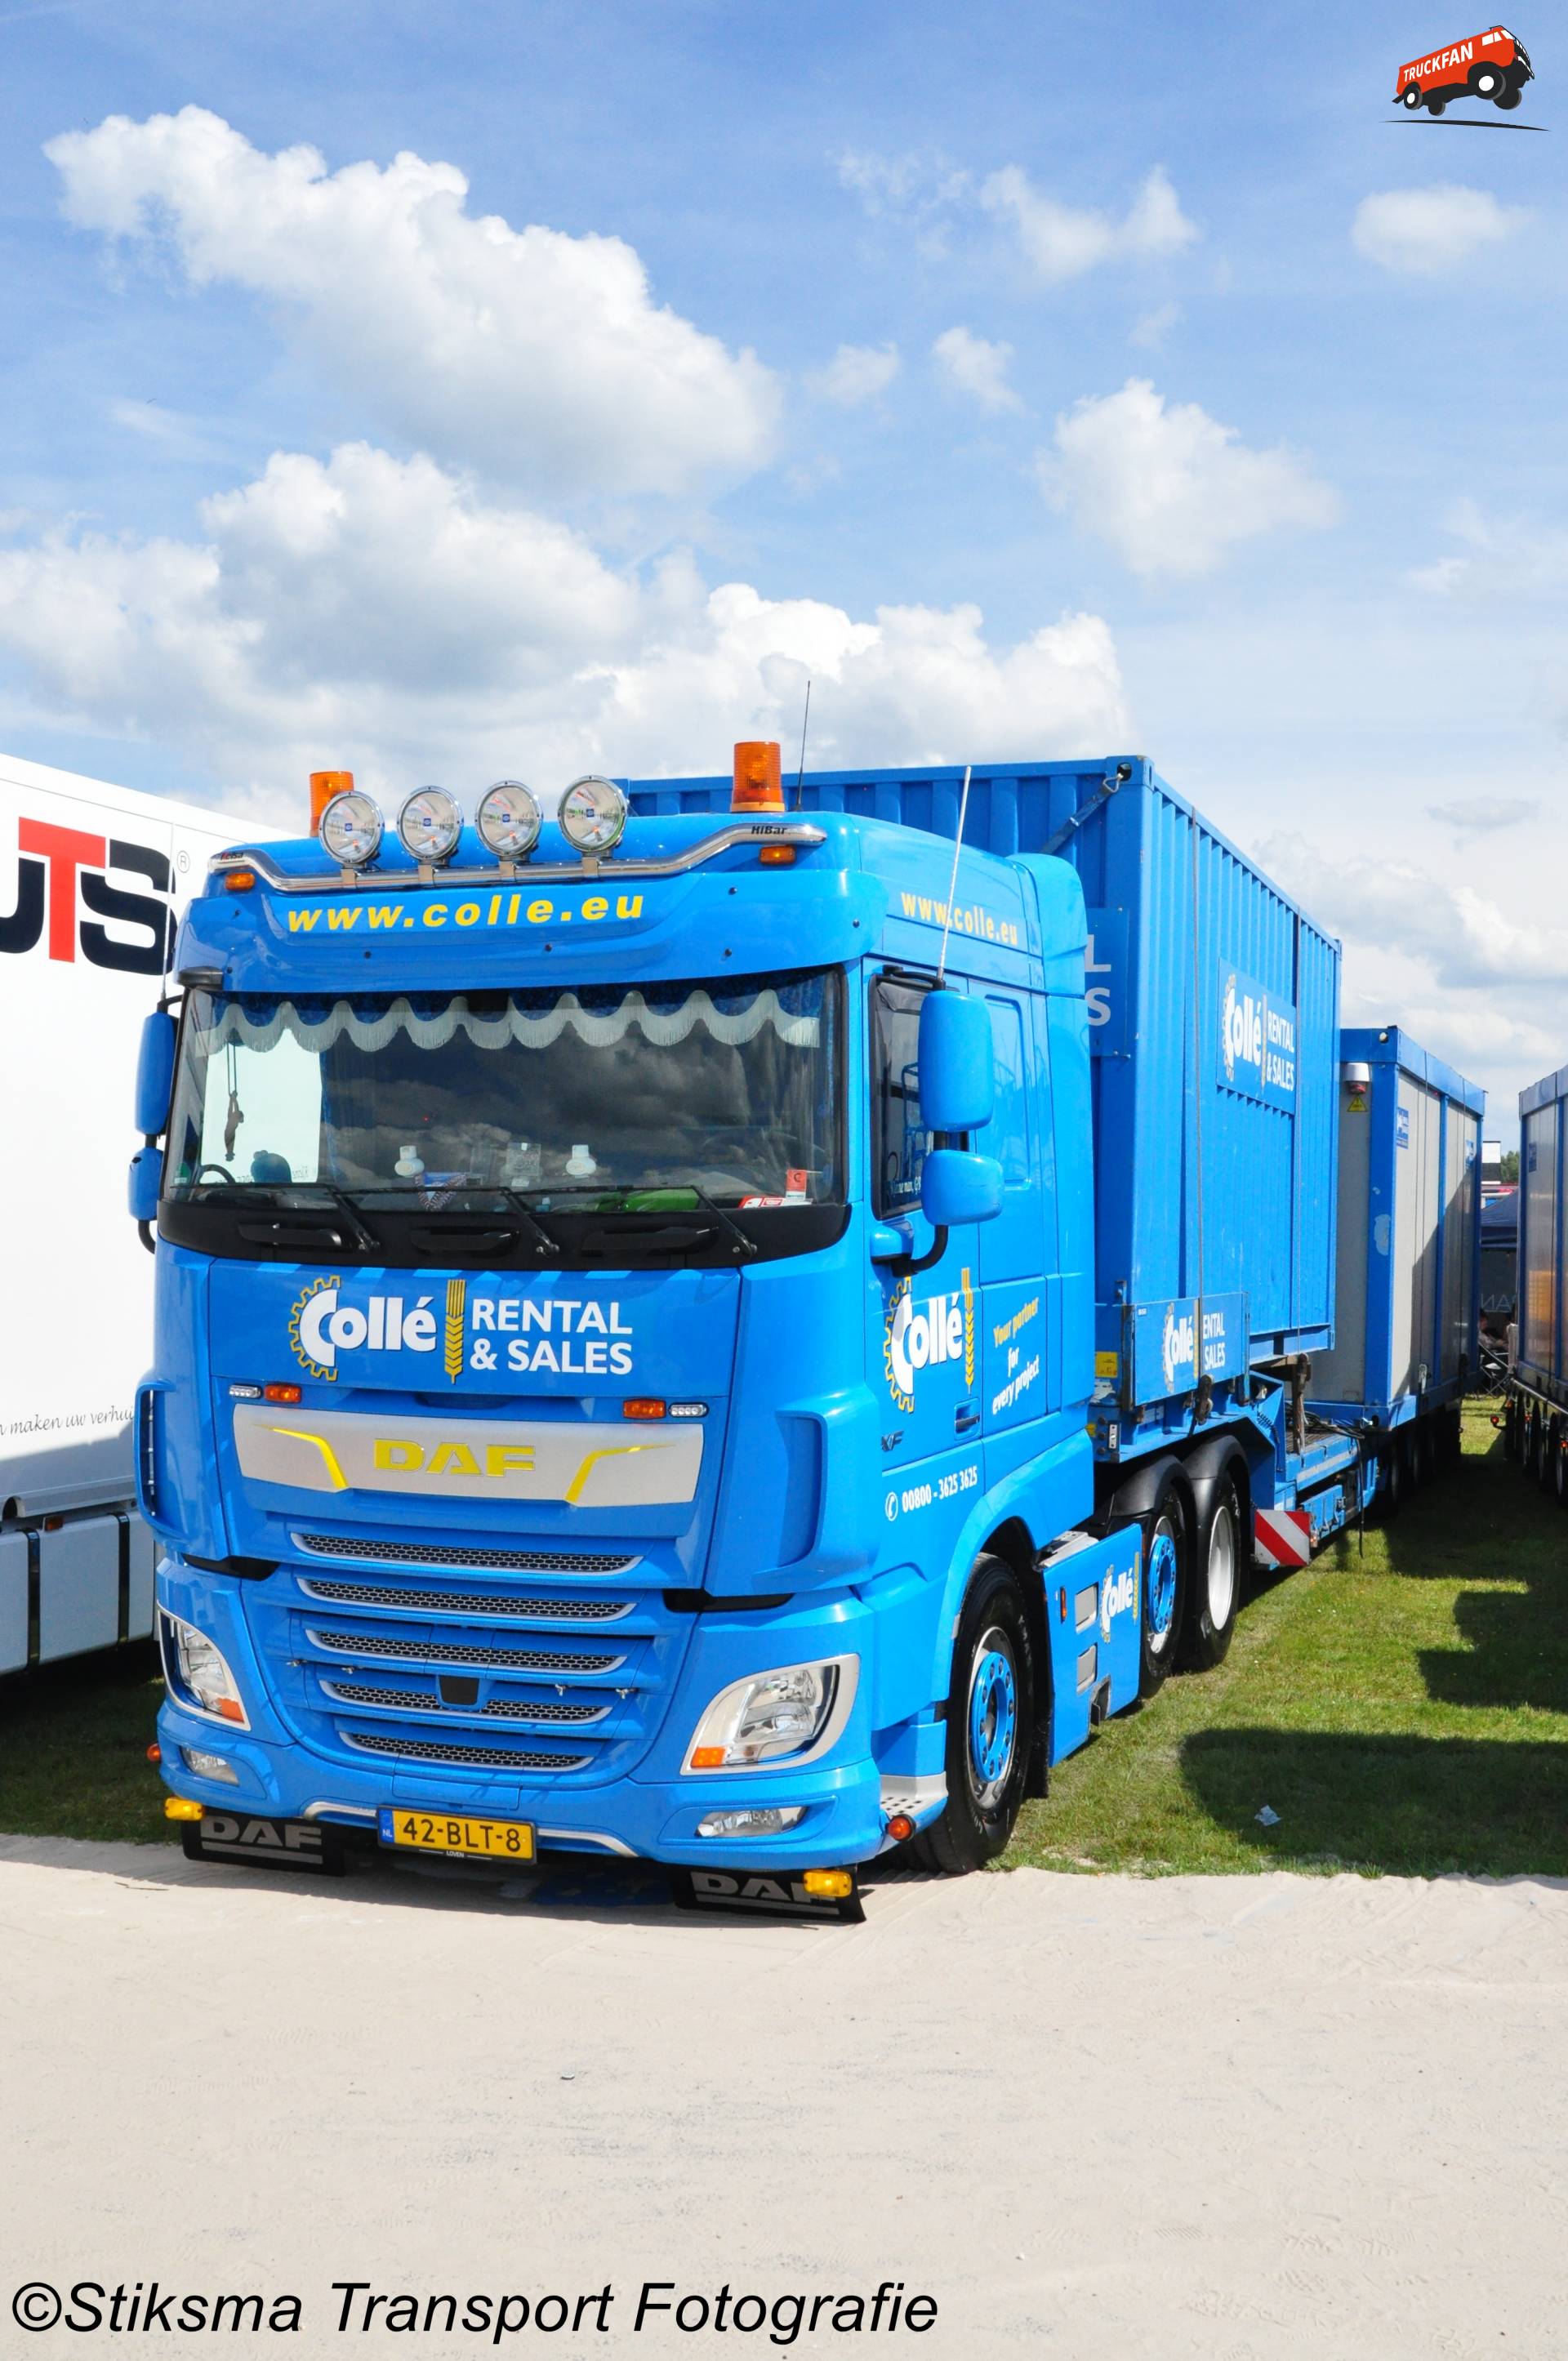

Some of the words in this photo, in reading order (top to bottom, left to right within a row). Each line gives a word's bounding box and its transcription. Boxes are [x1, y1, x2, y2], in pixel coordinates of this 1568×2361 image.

[751, 826, 787, 835] HiBar
[287, 893, 644, 933] www.colle.eu
[901, 891, 1018, 947] www.colle.eu
[1225, 987, 1262, 1067] Collé
[1267, 1009, 1294, 1054] RENTAL
[1272, 1054, 1294, 1092] SALES
[299, 1289, 437, 1367] Collé
[472, 1299, 633, 1334] RENTAL
[993, 1319, 1012, 1348] Your
[1013, 1296, 1039, 1339] partner
[1203, 1312, 1226, 1340] ENTAL
[470, 1338, 497, 1370] &
[508, 1339, 633, 1375] SALES
[891, 1293, 963, 1394] Collé
[1008, 1347, 1019, 1379] for
[1165, 1314, 1194, 1383] Collé
[1204, 1342, 1226, 1371] SALES
[992, 1380, 1015, 1415] every
[1014, 1354, 1040, 1401] project
[10, 1414, 61, 1436] maken
[65, 1414, 86, 1428] uw
[880, 1430, 904, 1452] XF
[373, 1437, 537, 1477] DAF
[902, 1483, 932, 1513] 00800
[938, 1472, 959, 1499] 3625
[959, 1465, 978, 1491] 3625
[1102, 1567, 1134, 1634] Collé
[200, 1815, 323, 1849] DAF
[382, 1829, 393, 1838] NL
[403, 1816, 521, 1853] 42-BLT-8
